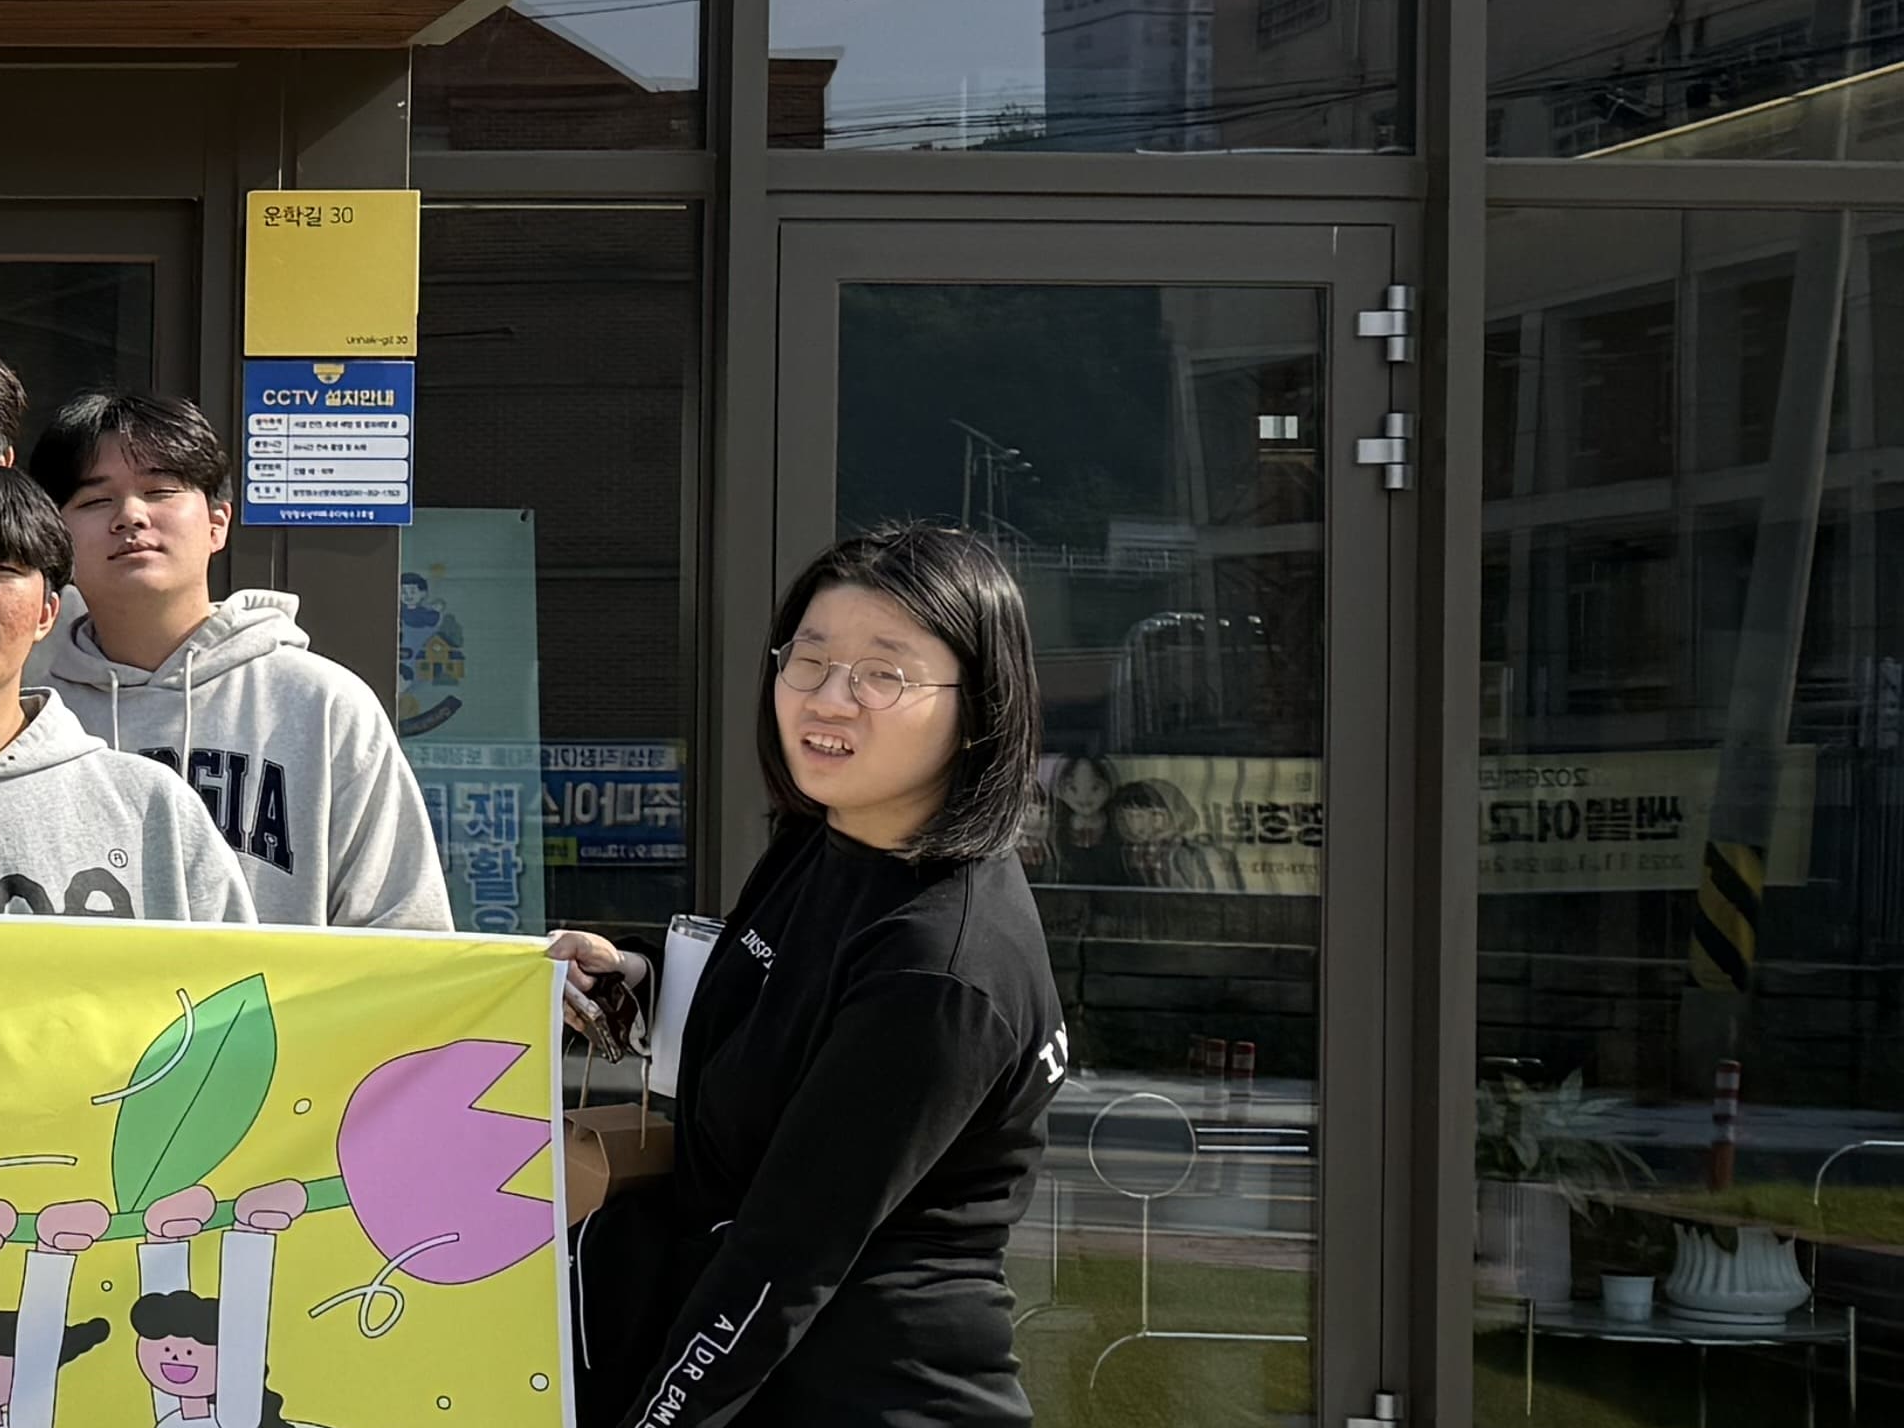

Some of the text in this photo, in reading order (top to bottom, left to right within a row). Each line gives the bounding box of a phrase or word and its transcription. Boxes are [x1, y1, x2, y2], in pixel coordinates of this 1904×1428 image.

[264, 205, 354, 227] 운학길 30
[263, 389, 394, 407] CCTV 설치안내
[137, 746, 294, 876] GIA
